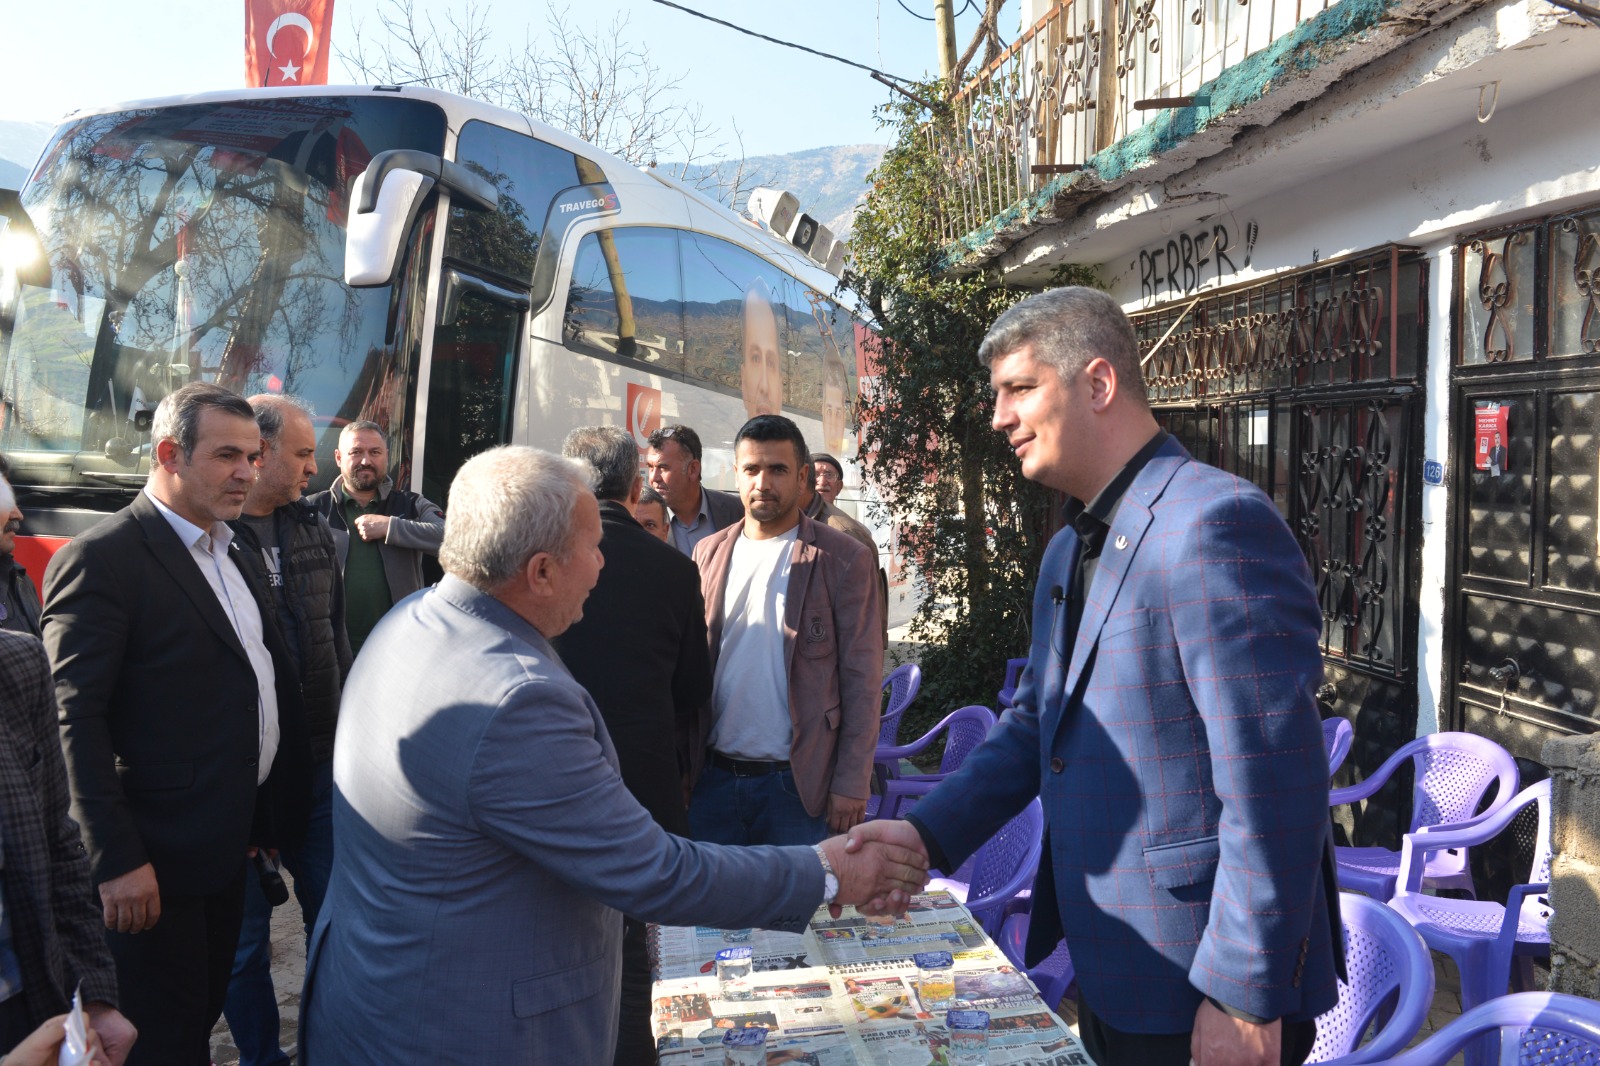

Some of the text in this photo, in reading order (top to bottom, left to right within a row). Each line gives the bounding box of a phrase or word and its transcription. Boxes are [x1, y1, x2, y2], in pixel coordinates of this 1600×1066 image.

[560, 198, 605, 213] TRAVEGO
[1426, 465, 1441, 479] 126
[782, 954, 812, 970] X
